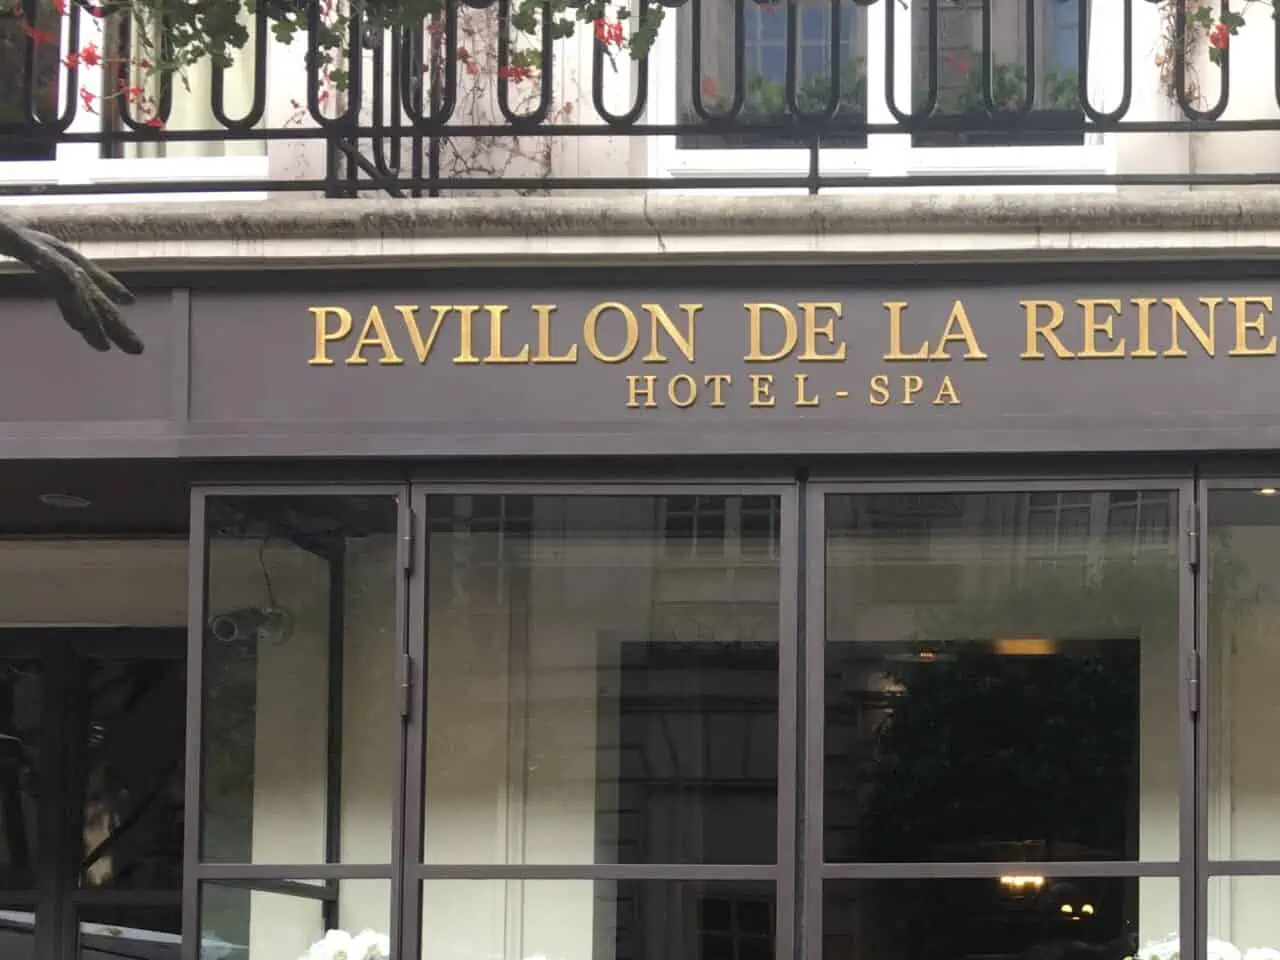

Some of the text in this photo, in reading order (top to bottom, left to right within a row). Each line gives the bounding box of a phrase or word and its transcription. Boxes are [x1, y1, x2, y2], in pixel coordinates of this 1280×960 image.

[307, 296, 1277, 365] PAVILLON DE LA REINE
[625, 374, 819, 408] HOTEL
[868, 374, 962, 406] SPA
